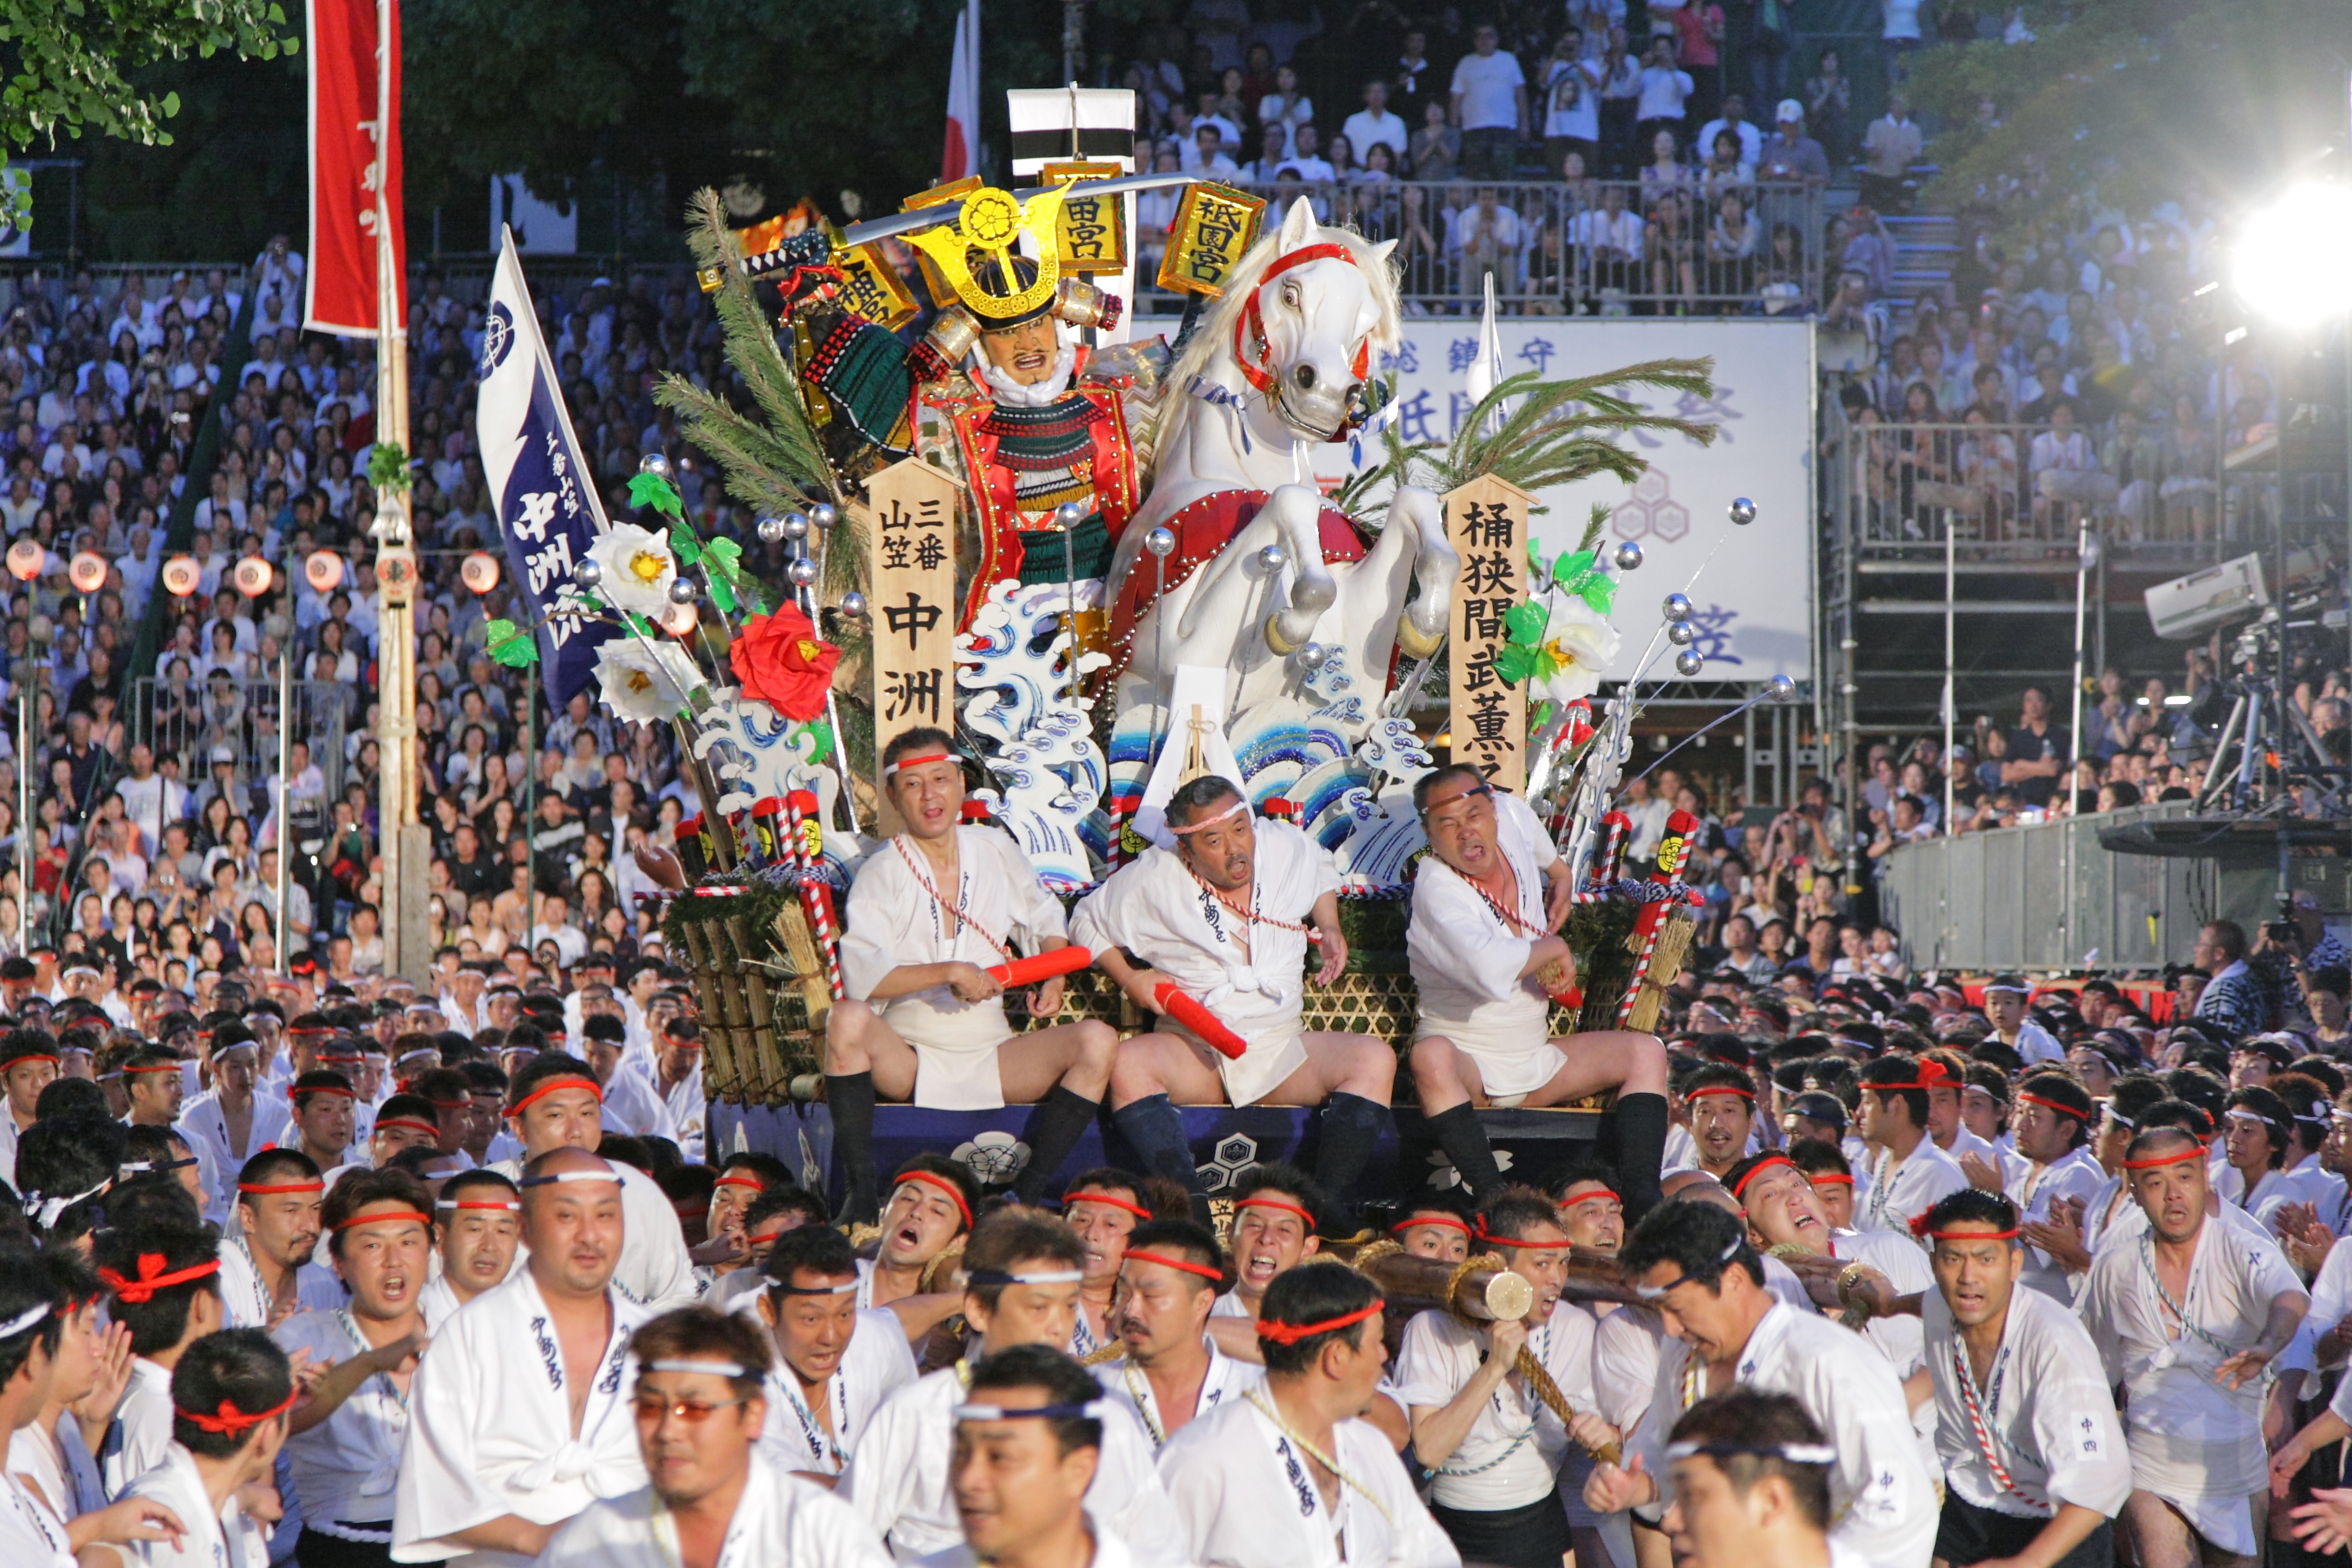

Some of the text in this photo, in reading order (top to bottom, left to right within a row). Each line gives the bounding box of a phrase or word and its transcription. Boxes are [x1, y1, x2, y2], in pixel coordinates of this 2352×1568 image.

[1066, 182, 1107, 258] 田宮
[1189, 198, 1242, 284] 祇園宮
[879, 499, 912, 570] 山笠
[913, 499, 948, 571] 三番
[882, 591, 943, 725] 中洲
[2080, 1417, 2097, 1452] 中四
